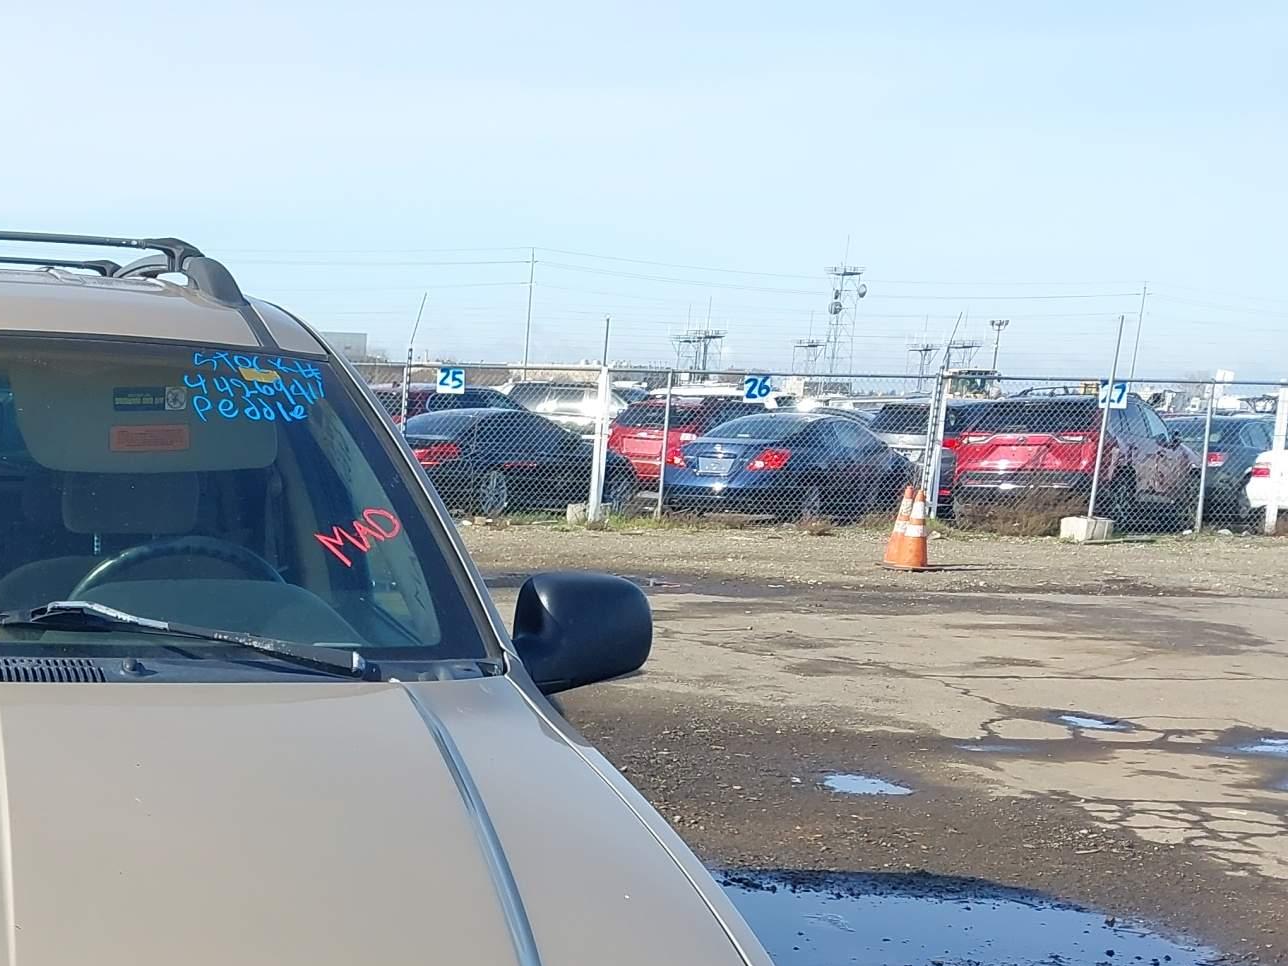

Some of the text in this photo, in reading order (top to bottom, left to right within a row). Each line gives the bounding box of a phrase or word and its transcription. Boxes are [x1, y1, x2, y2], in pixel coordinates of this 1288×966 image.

[183, 373, 325, 405] 44269411
[439, 367, 464, 389] 25
[744, 375, 771, 399] 26
